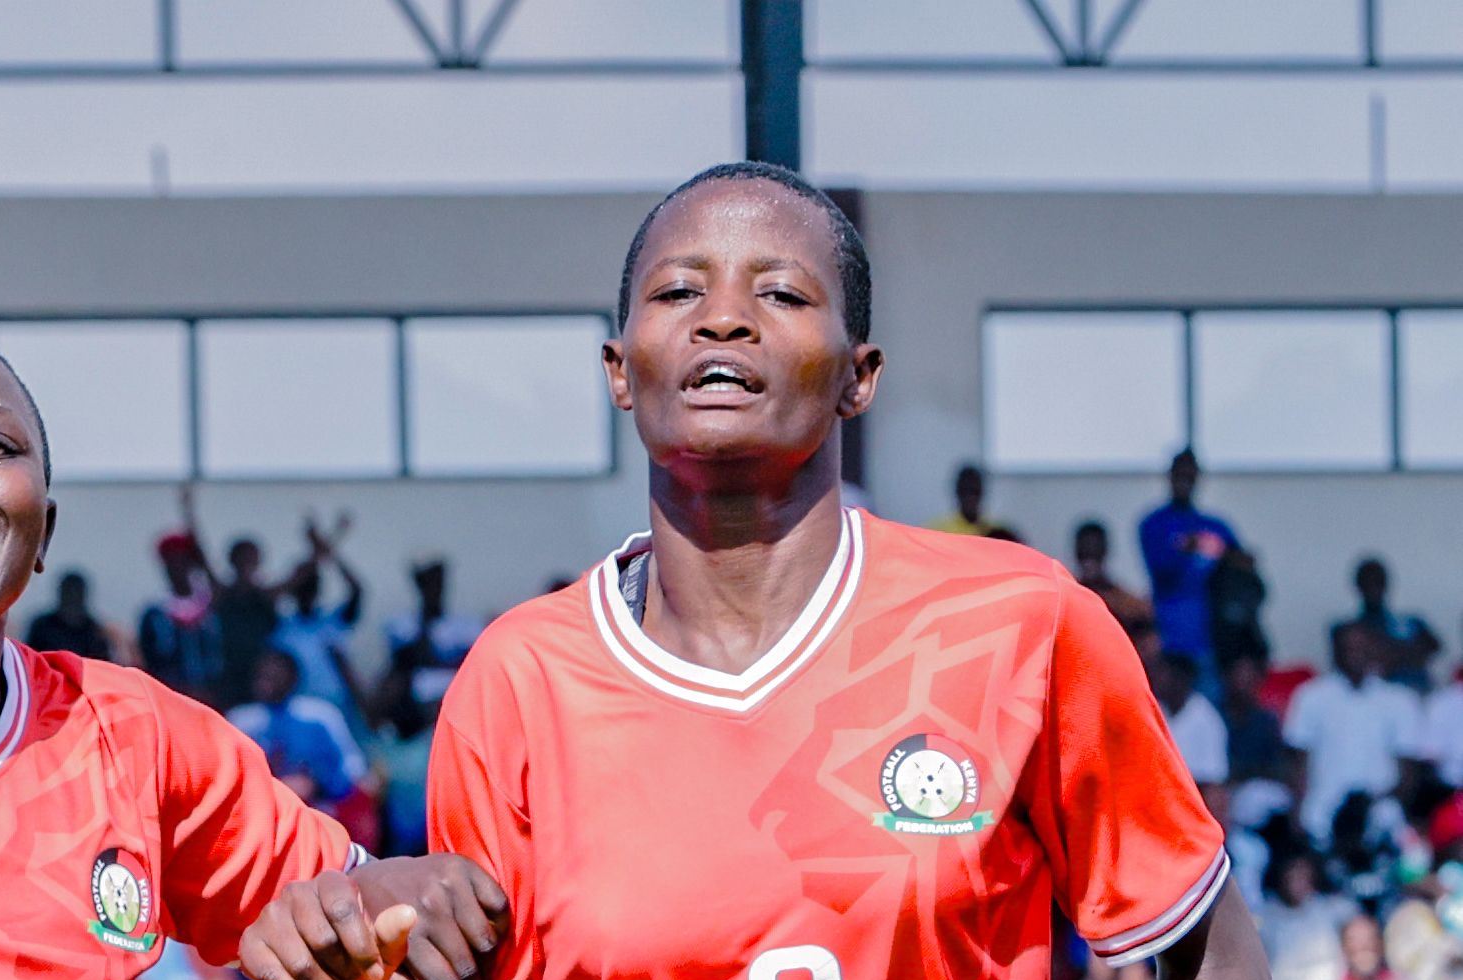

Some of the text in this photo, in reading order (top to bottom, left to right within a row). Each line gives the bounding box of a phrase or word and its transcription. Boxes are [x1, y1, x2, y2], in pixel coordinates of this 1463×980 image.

[882, 749, 906, 812] FOOTBALL
[960, 759, 978, 803] KENYA
[895, 821, 974, 834] FEDERATION
[92, 859, 107, 921] FOOTBALL
[138, 878, 149, 922] KENYA
